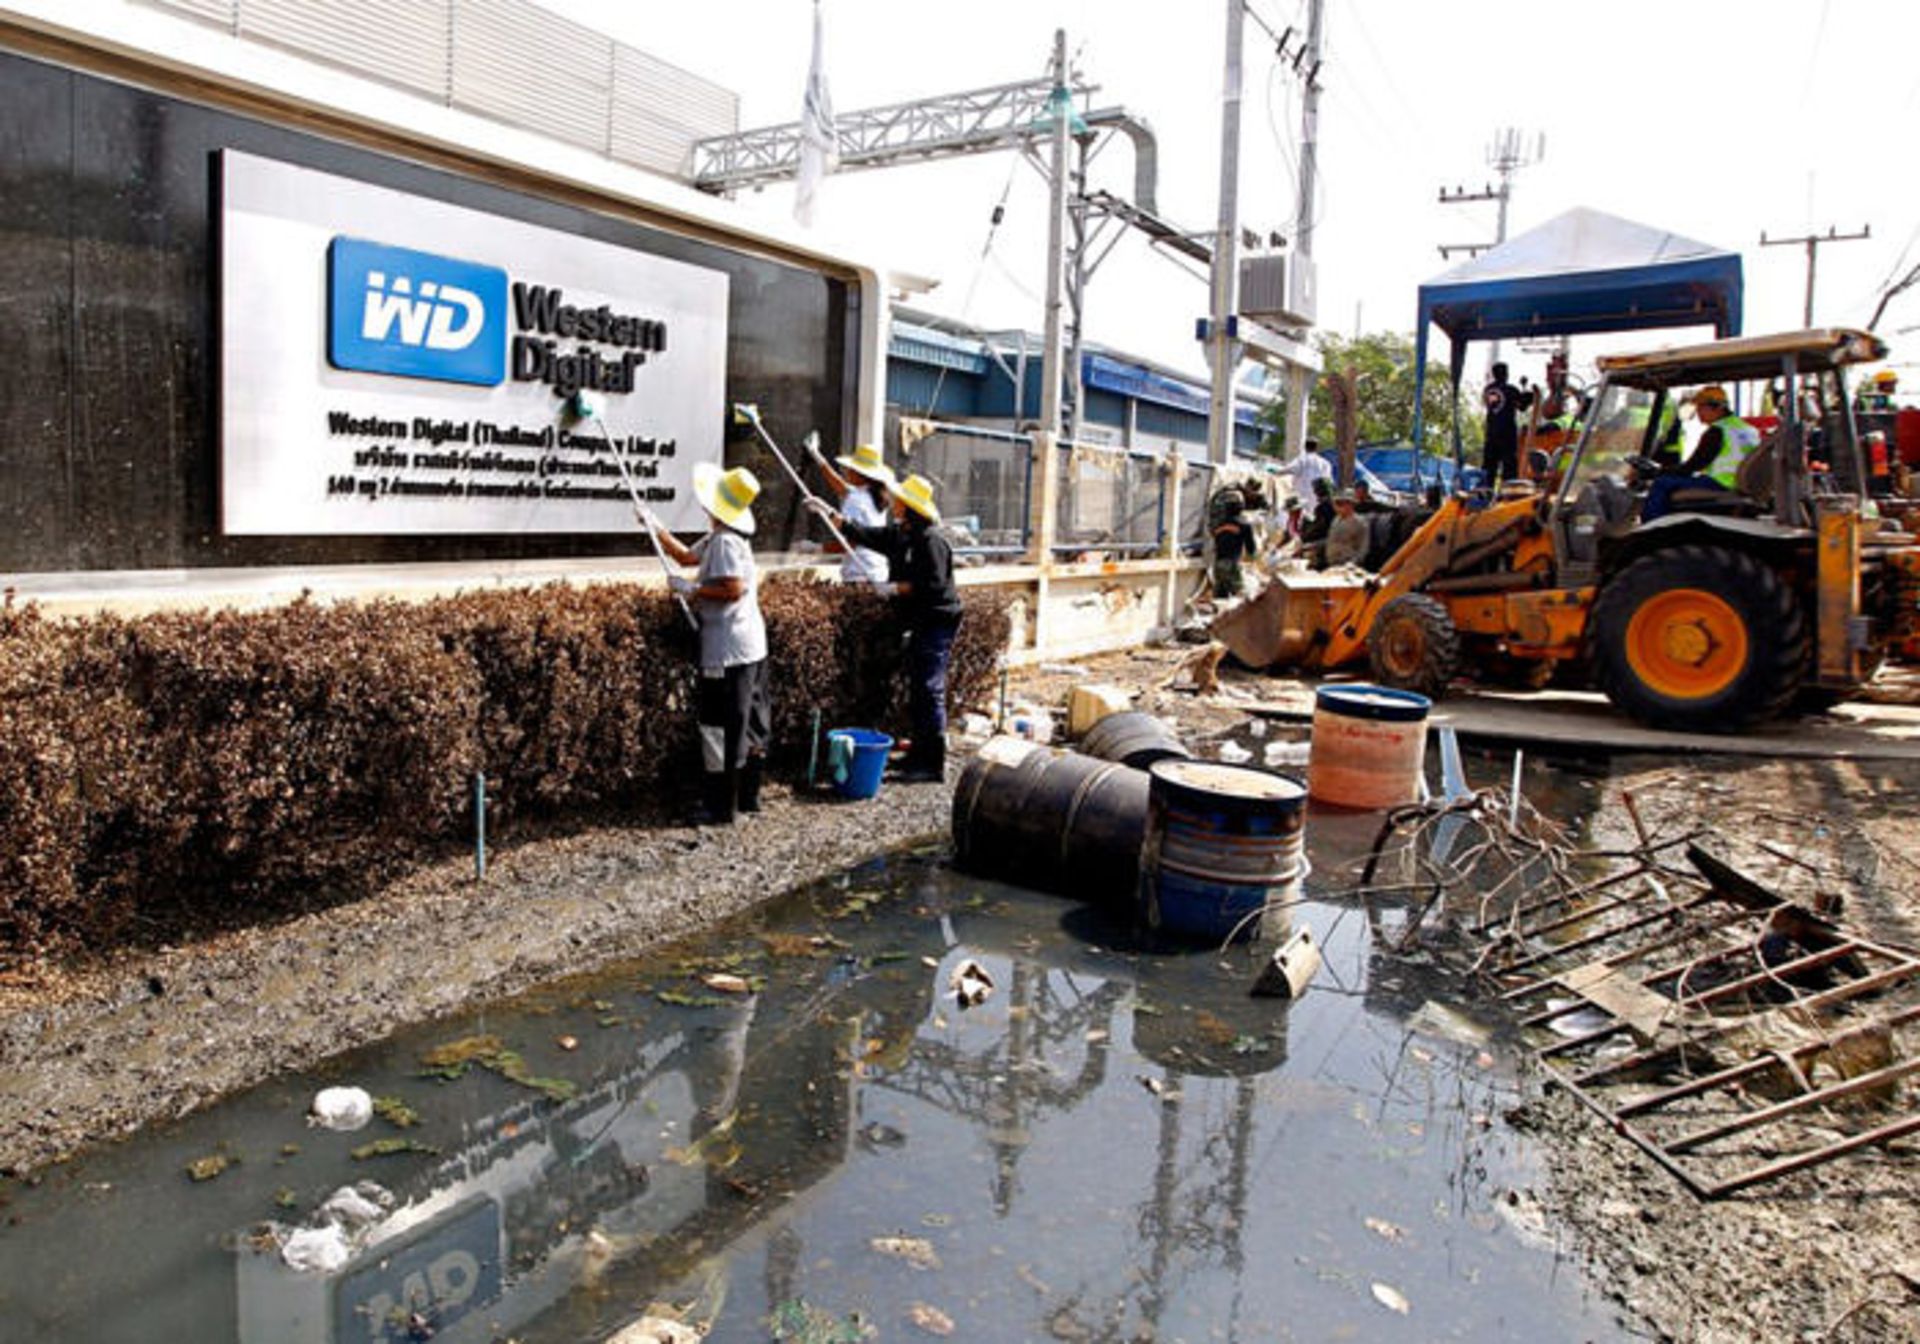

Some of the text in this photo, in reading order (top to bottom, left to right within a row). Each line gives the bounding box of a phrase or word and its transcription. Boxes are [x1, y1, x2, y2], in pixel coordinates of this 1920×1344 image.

[361, 270, 485, 351] WD
[512, 281, 667, 352] Western
[511, 335, 642, 398] Digital
[328, 411, 407, 439] Western
[412, 416, 469, 447] Digital
[473, 419, 554, 449] (Thailand)
